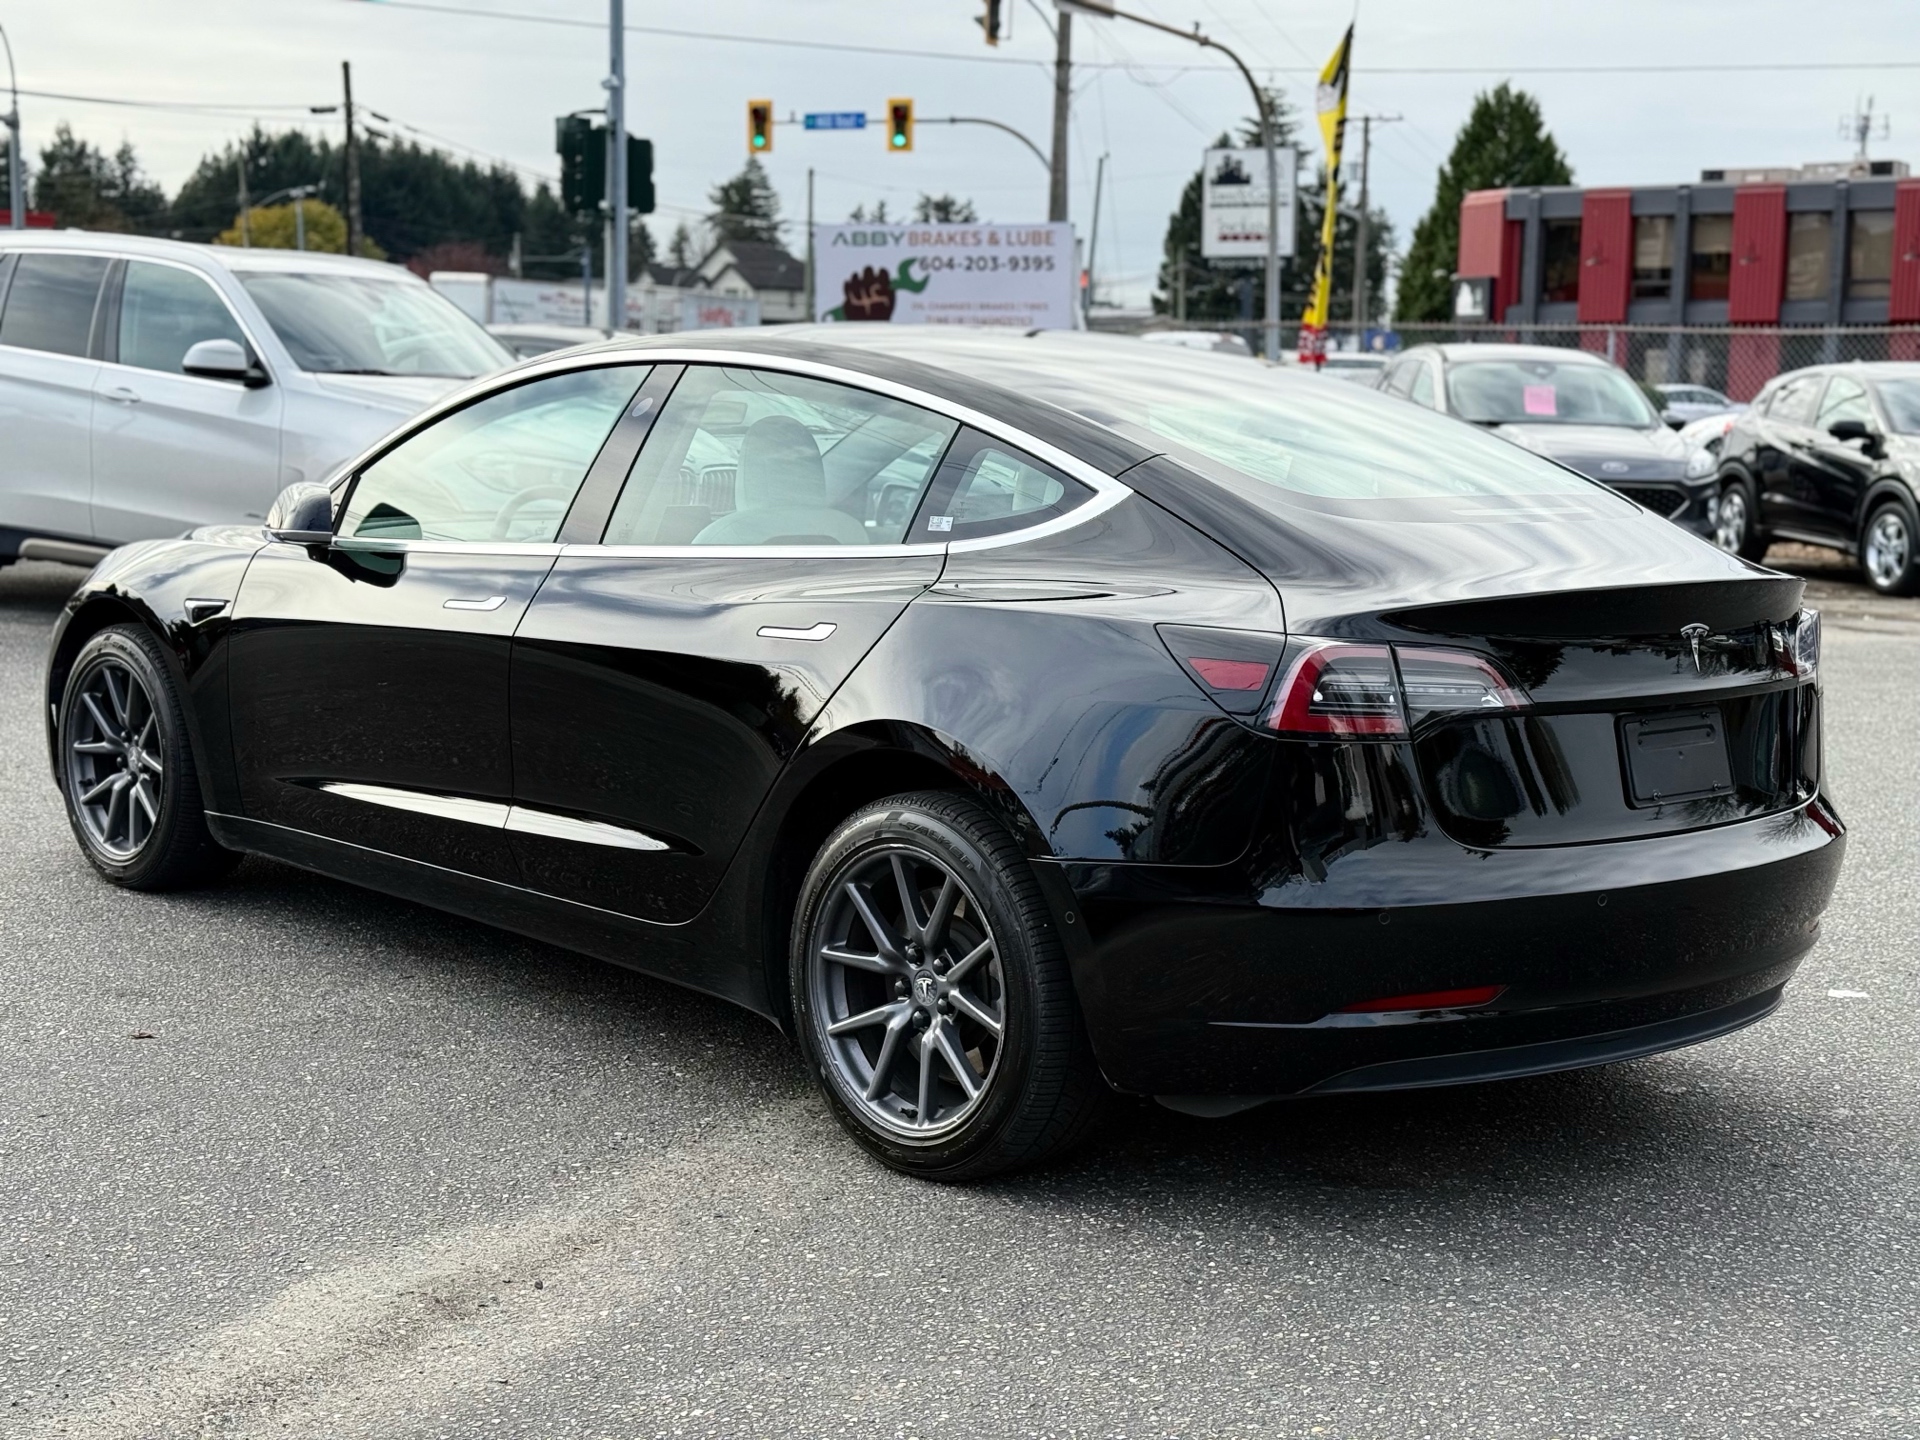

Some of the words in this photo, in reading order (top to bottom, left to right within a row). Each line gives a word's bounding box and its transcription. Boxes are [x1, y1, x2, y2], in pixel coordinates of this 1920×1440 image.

[831, 230, 905, 248] ABBY
[907, 230, 982, 247] BRAKES
[987, 231, 1000, 247] &
[1006, 230, 1056, 247] LUBE
[918, 255, 1055, 272] 604-203-9395
